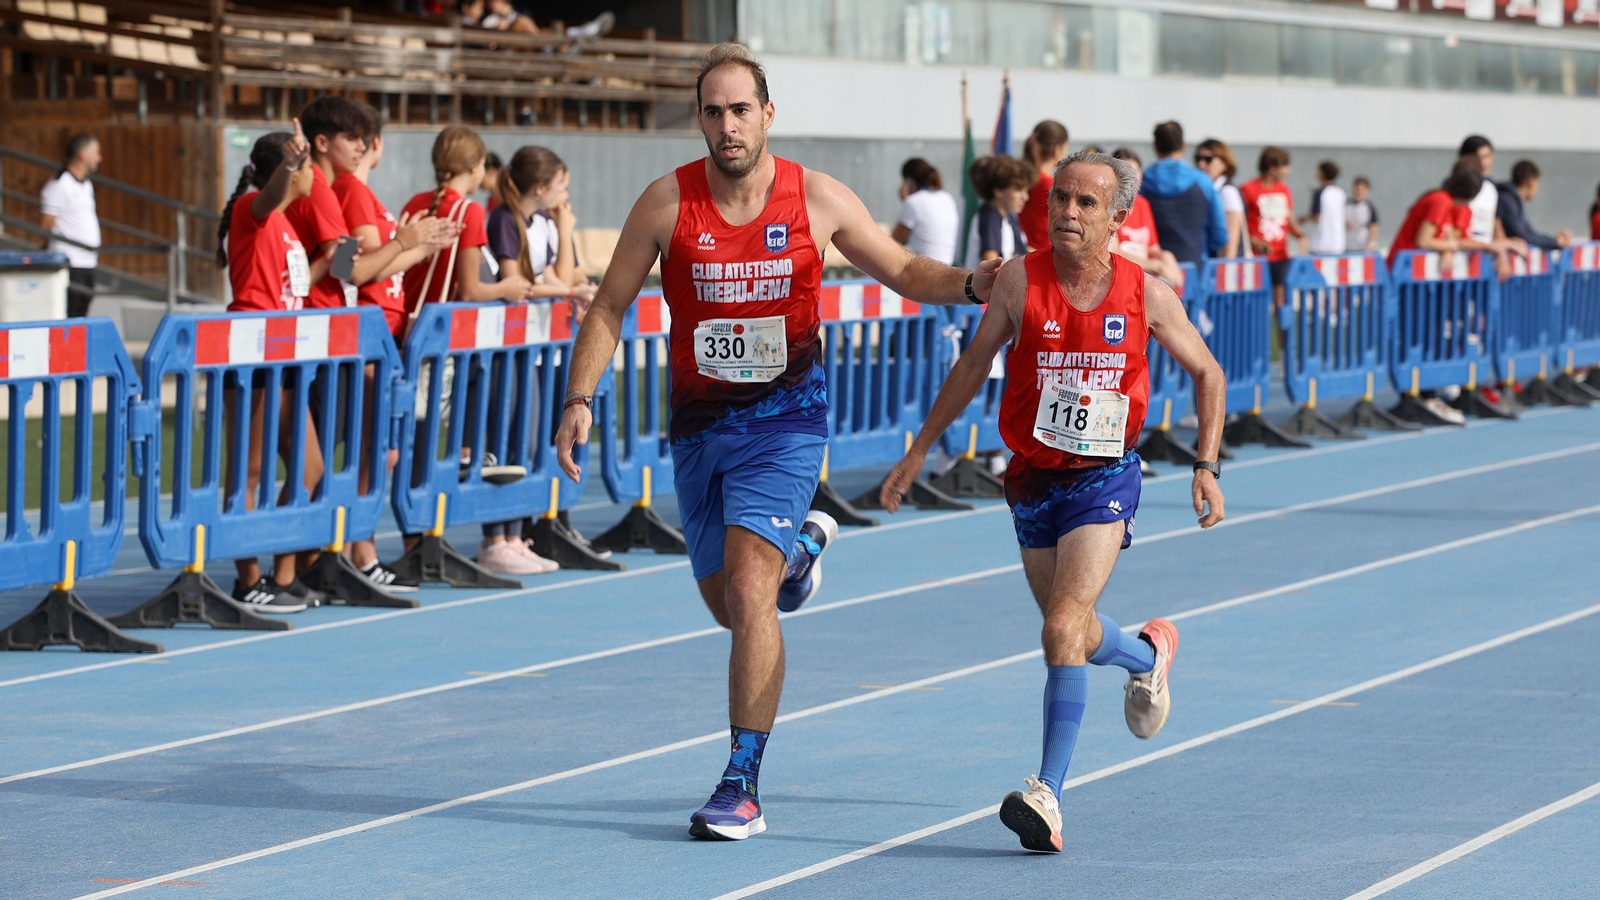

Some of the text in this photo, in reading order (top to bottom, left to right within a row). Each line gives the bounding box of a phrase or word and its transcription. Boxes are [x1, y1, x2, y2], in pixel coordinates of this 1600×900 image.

[692, 258, 793, 279] CLUB ATLETISMO
[693, 278, 792, 303] TREBUJENA
[704, 336, 745, 359] 330
[1036, 352, 1127, 369] CLUB ATLETISMO
[1048, 402, 1088, 430] 118
